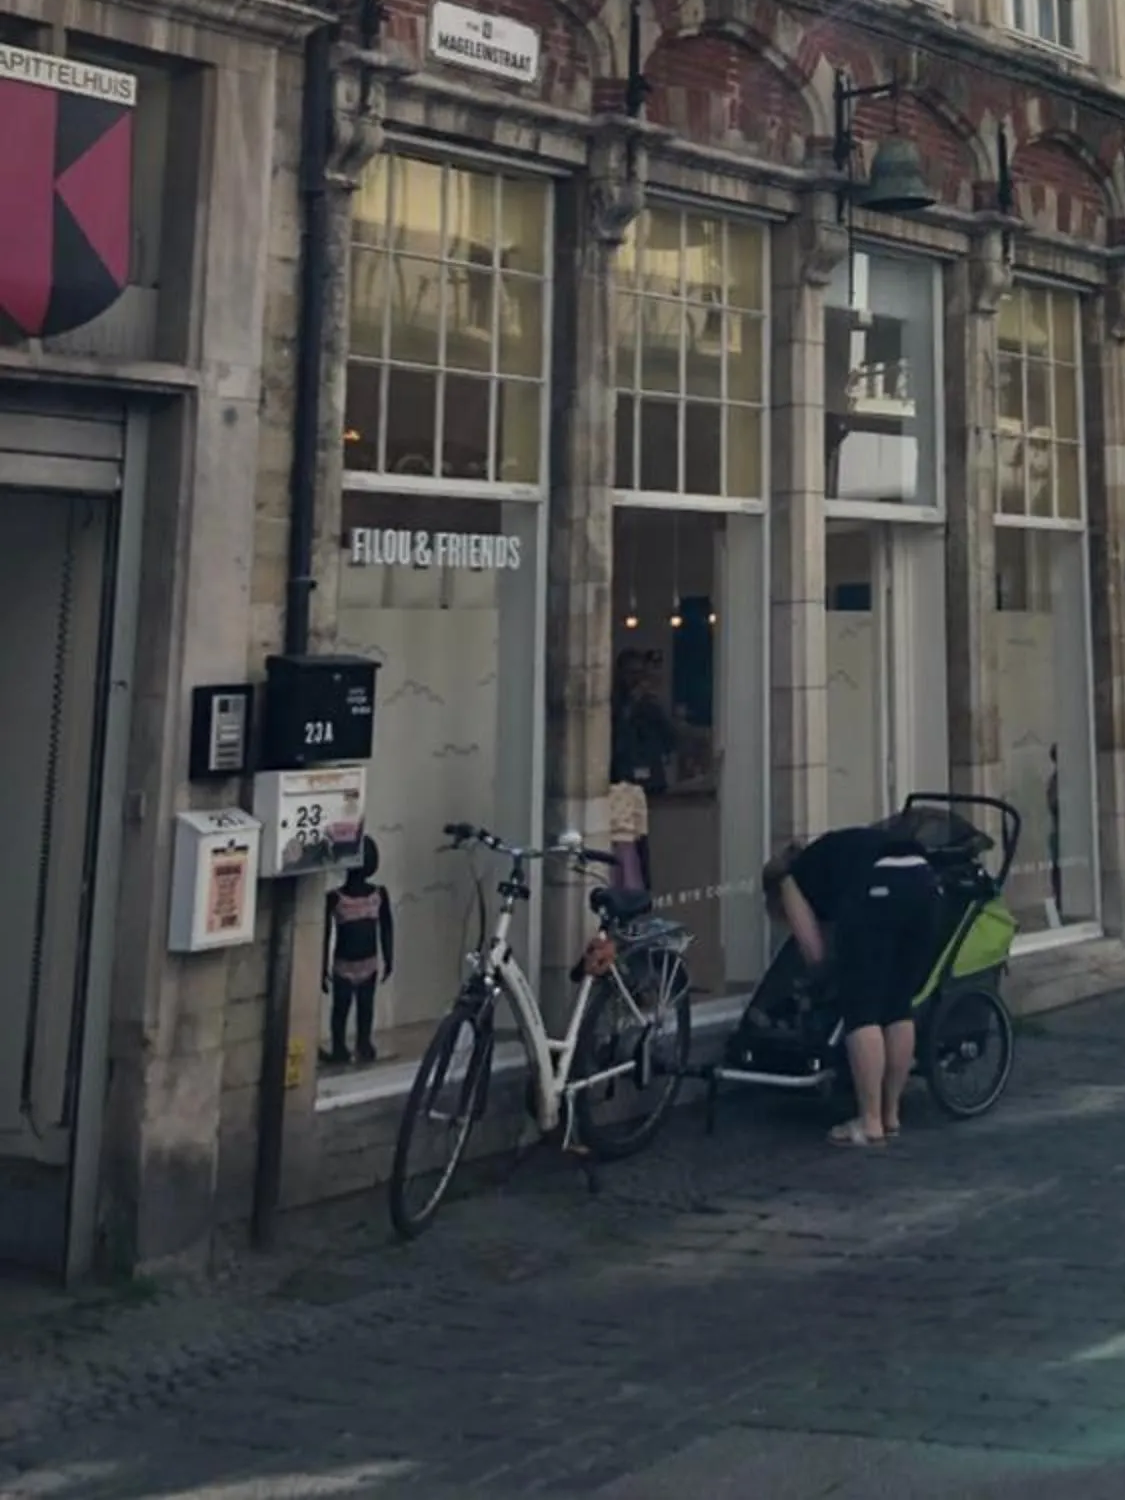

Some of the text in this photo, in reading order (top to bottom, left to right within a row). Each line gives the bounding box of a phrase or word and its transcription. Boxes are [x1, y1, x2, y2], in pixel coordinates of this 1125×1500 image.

[351, 527, 411, 565] FILOU
[434, 532, 521, 570] FRIENDS
[305, 721, 334, 745] 23A
[296, 804, 322, 829] 23
